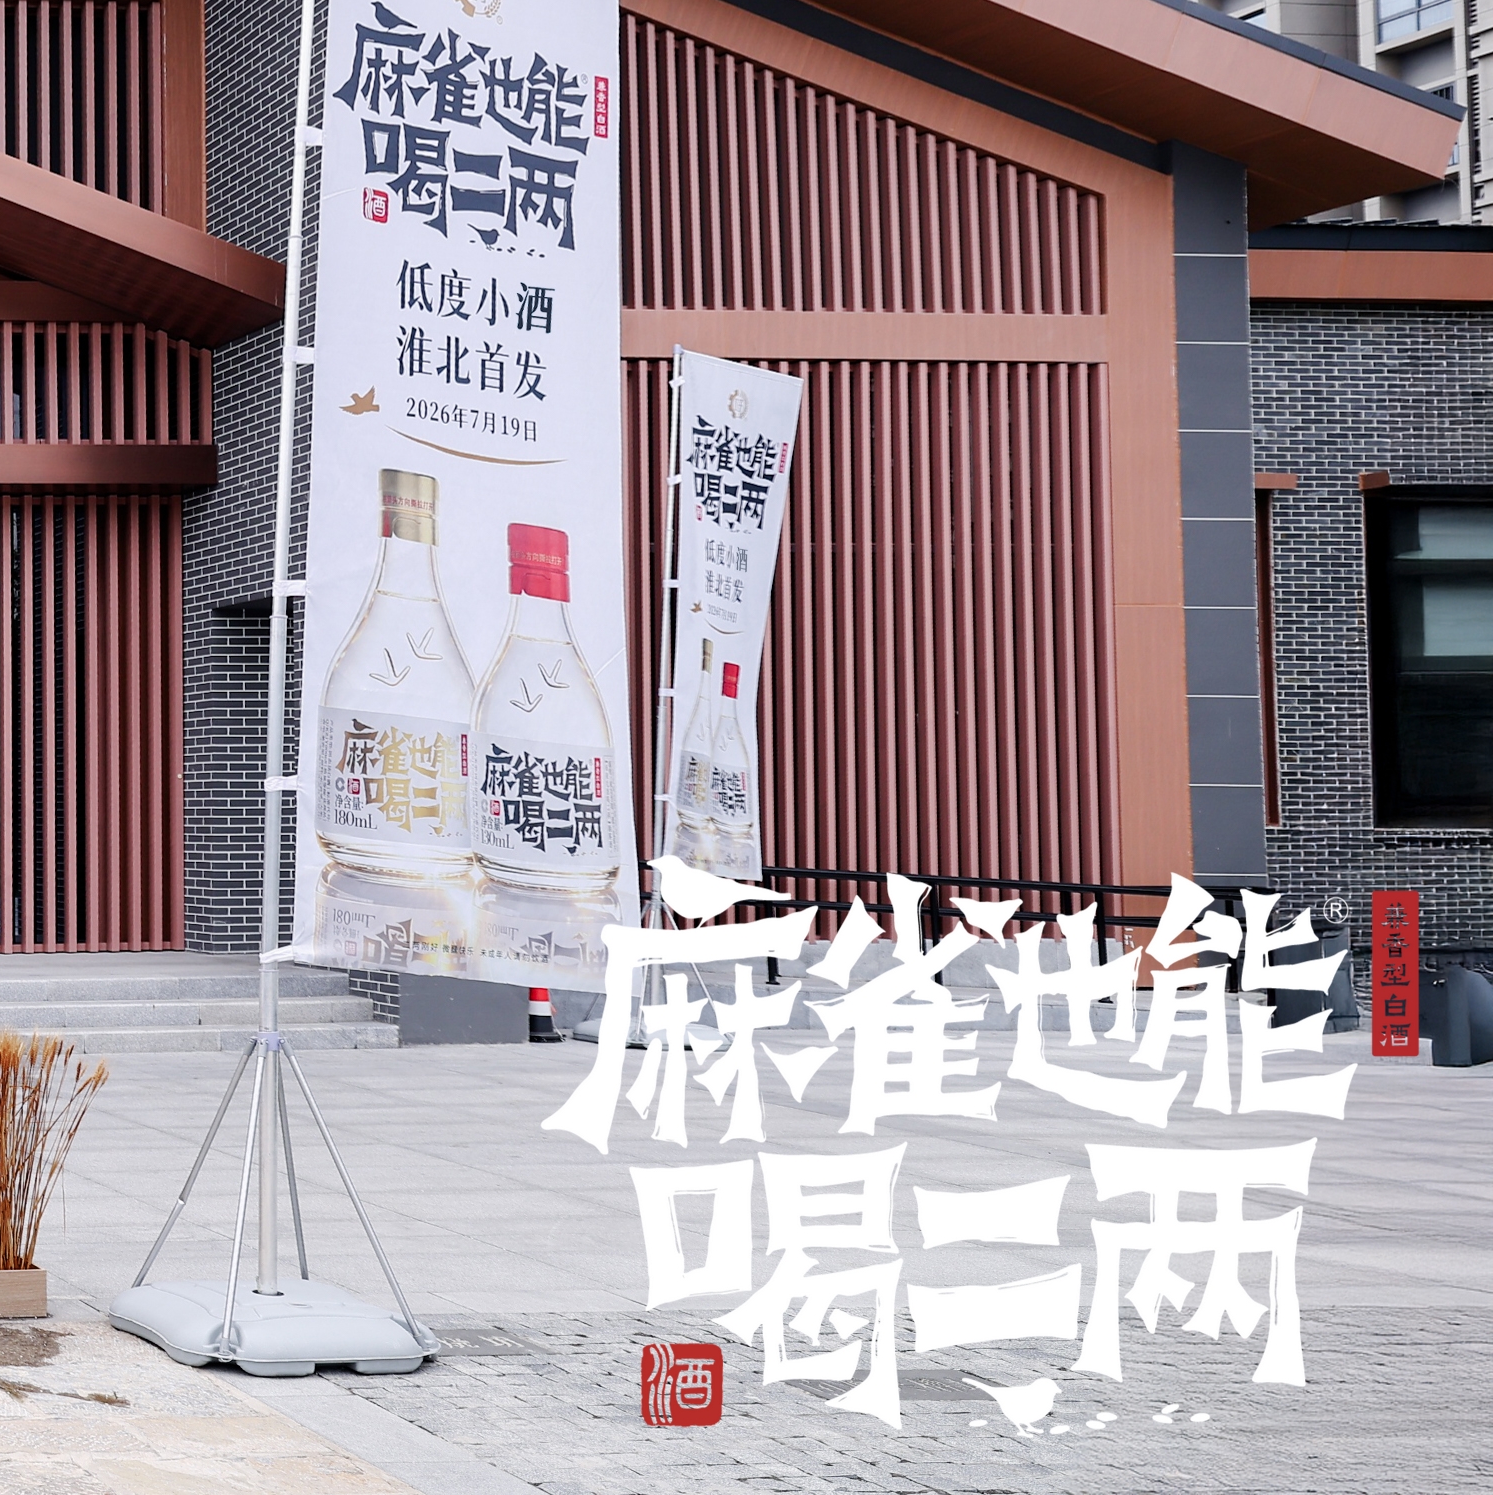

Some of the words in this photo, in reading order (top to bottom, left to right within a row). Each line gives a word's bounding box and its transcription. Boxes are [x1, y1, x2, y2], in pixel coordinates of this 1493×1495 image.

[332, 1, 590, 156] 麻雀也能
[361, 118, 579, 251] 喝二两
[396, 259, 555, 334] 低度小酒
[396, 325, 547, 402] 淮北首发
[406, 397, 537, 442] 2026年7月19日
[686, 415, 777, 482] 麻雀也能
[705, 538, 748, 572] 低度小酒
[705, 569, 744, 603] 淮北首发
[335, 718, 460, 780] 麻雀也能
[480, 743, 594, 801] 麻雀也能
[334, 809, 378, 830] 180mL
[364, 777, 468, 834] 喝二两
[504, 799, 604, 853] 喝二两
[480, 827, 514, 850] 130mL
